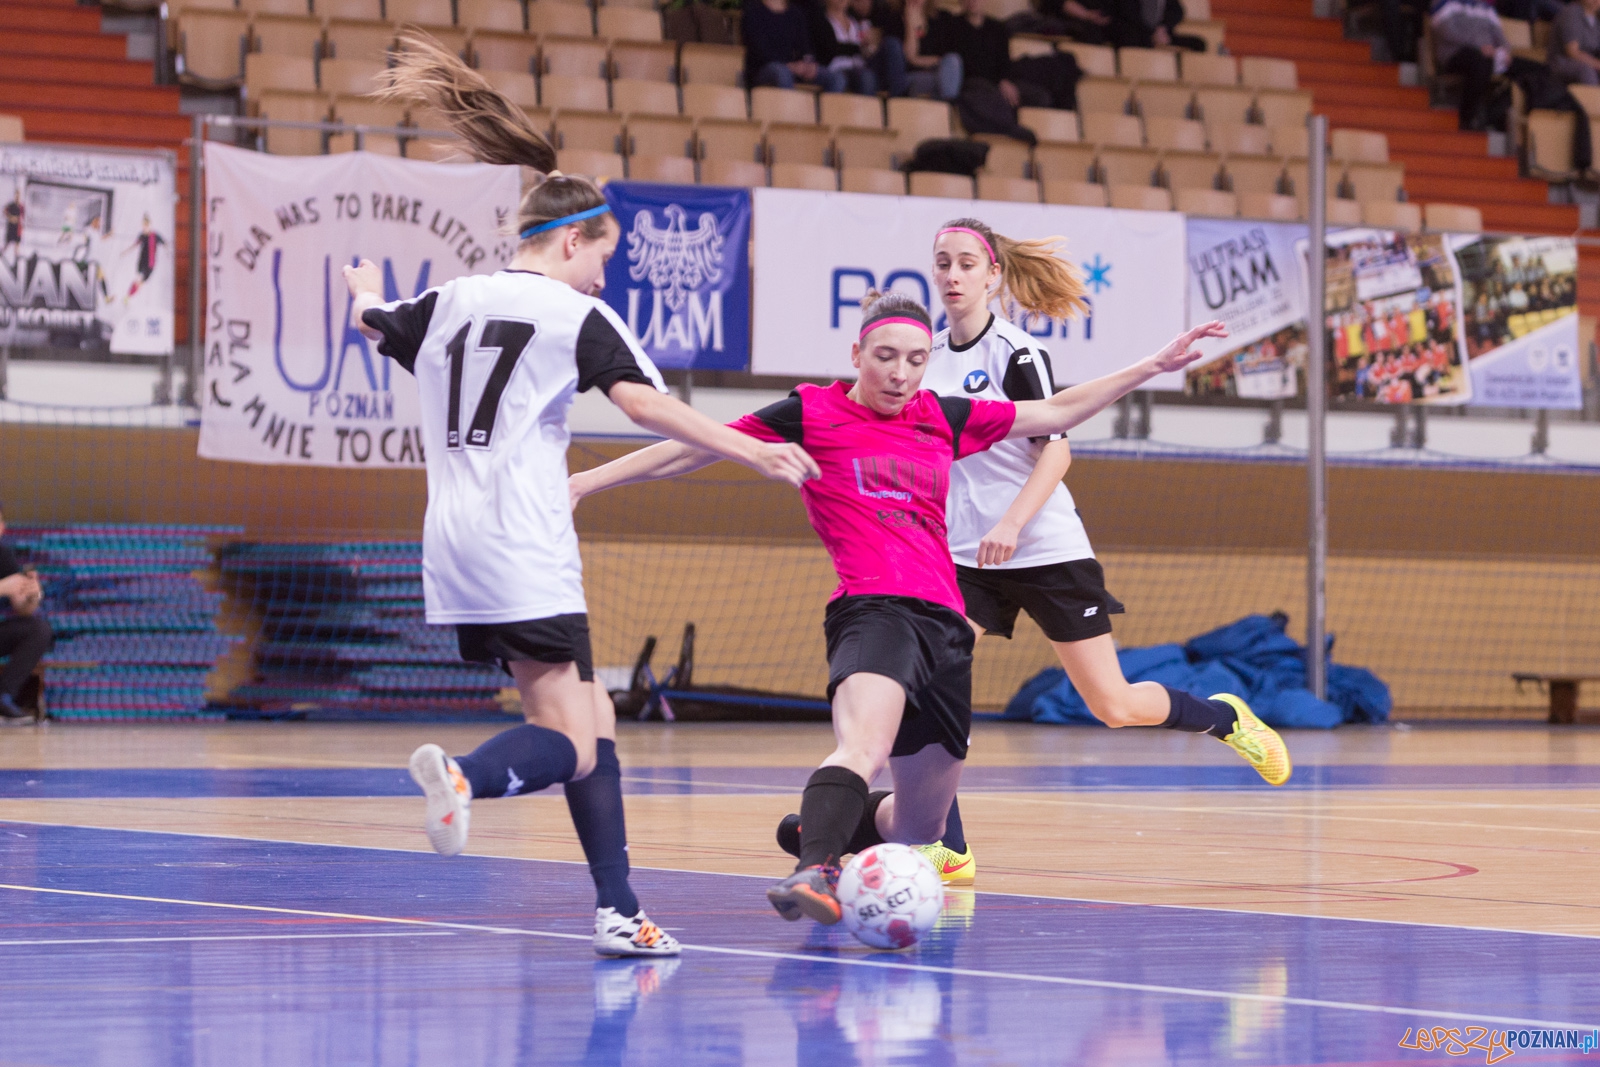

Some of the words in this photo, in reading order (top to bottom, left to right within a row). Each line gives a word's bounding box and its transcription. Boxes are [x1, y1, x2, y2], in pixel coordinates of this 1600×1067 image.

[235, 225, 272, 271] DLA
[334, 193, 361, 220] TO
[430, 209, 486, 270] LITER
[1198, 250, 1280, 310] UAM
[626, 288, 726, 352] UAM
[444, 314, 541, 452] 17
[242, 394, 314, 459] MNIE
[335, 427, 371, 462] TO
[858, 887, 915, 920] SELECT
